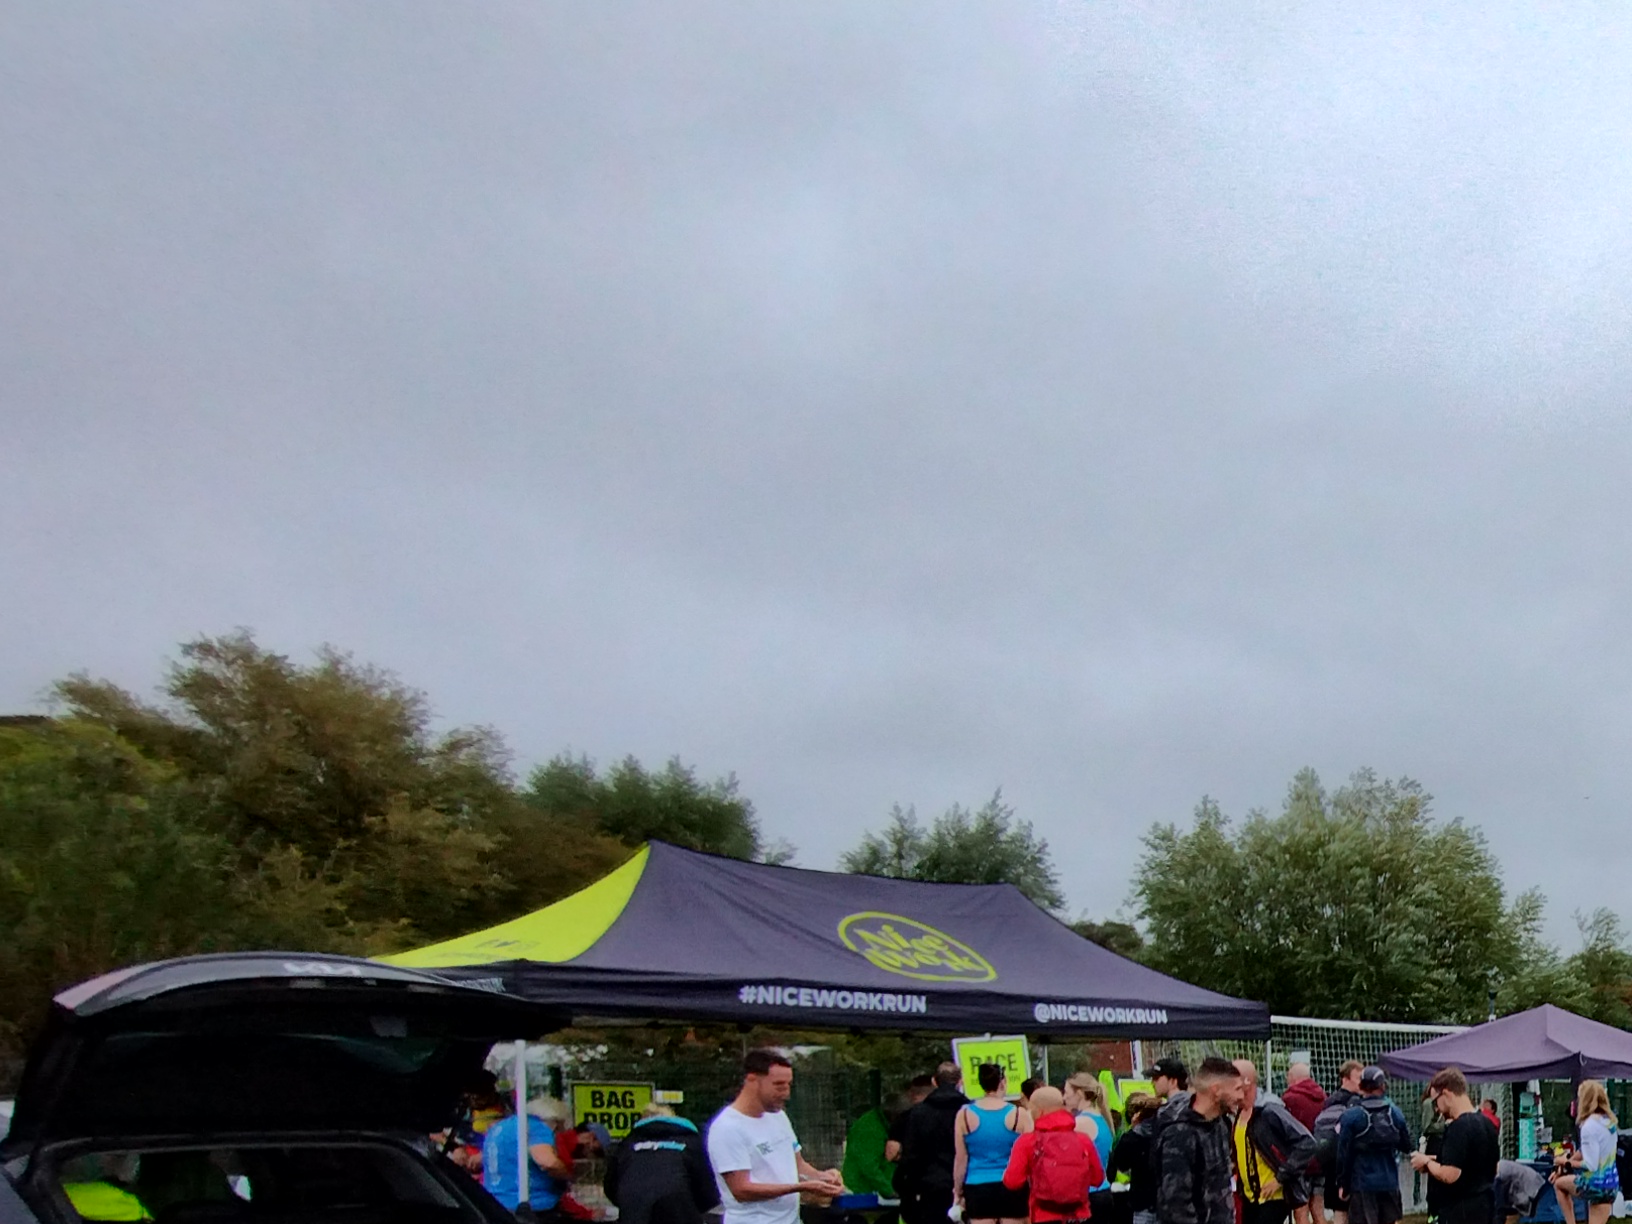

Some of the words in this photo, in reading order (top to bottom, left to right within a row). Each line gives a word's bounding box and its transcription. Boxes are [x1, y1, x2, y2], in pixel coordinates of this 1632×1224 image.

[739, 985, 927, 1013] #NICEWORKRUN
[1034, 1003, 1168, 1024] @NICEWORKRUN
[591, 1090, 635, 1109] BAG
